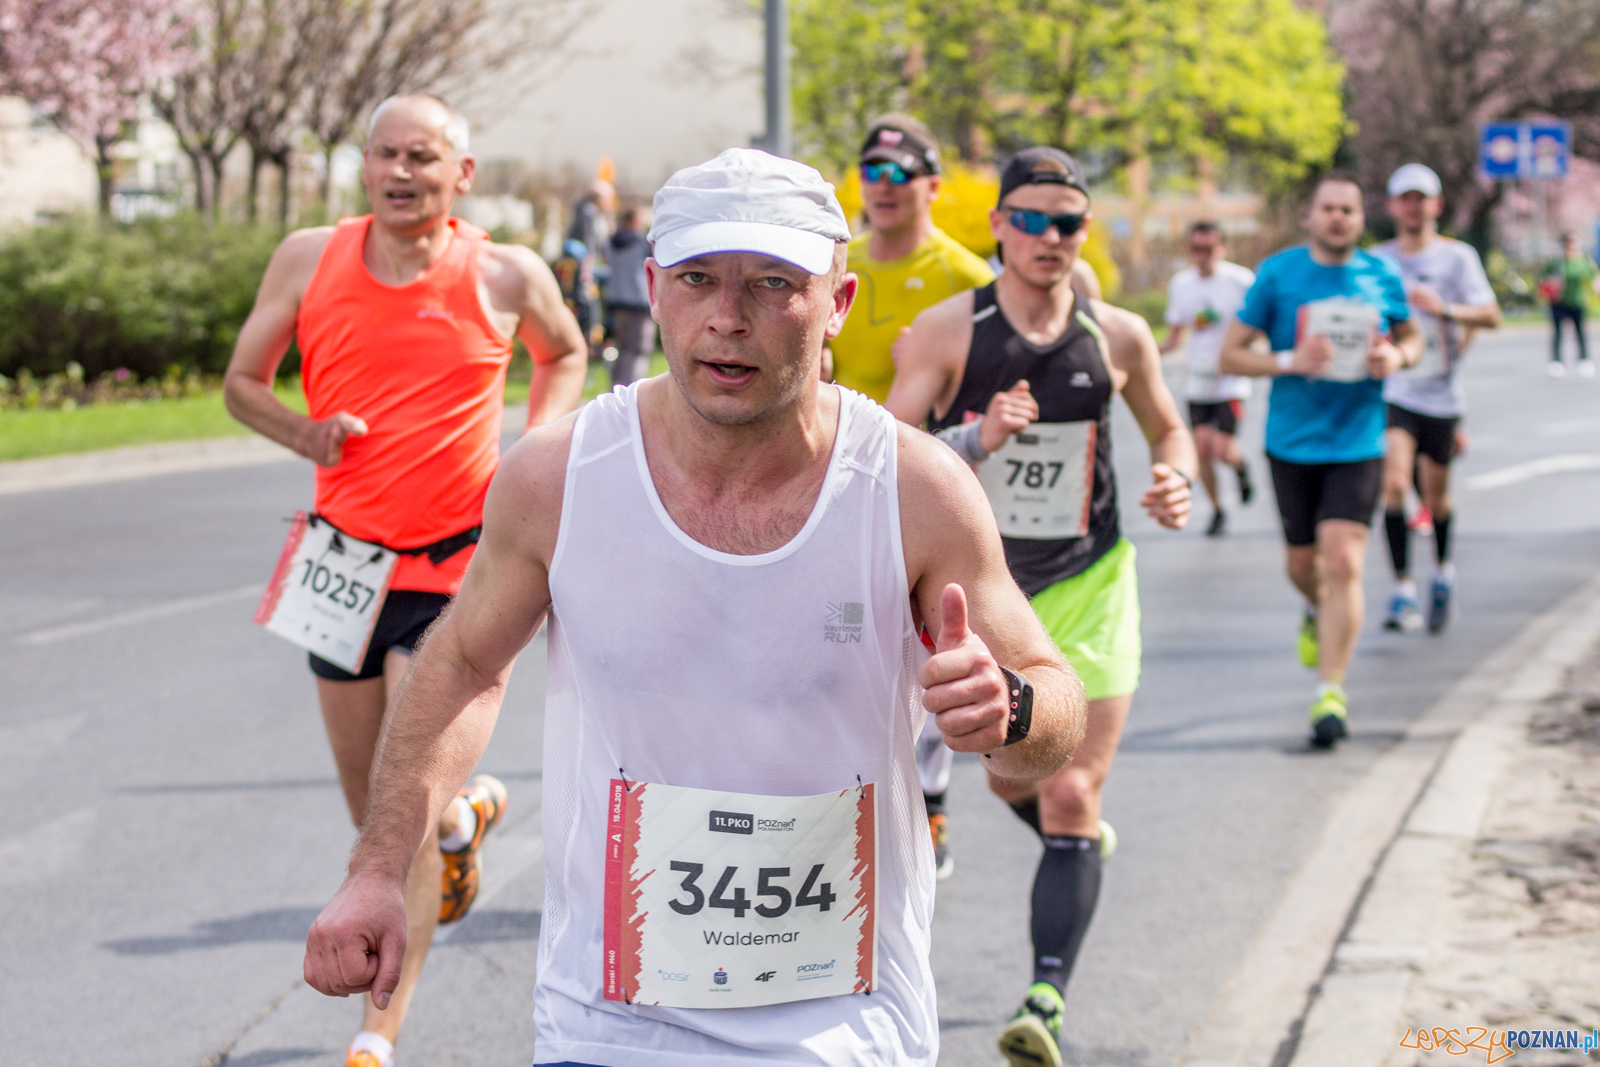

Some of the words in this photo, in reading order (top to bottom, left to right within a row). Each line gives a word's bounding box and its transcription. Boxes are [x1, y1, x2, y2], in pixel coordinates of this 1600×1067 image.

[1006, 459, 1064, 489] 787
[301, 558, 376, 614] 10257
[824, 632, 861, 643] RUN
[613, 785, 622, 822] 15.04.2018
[611, 834, 621, 842] A
[668, 860, 836, 918] 3454
[703, 930, 800, 946] Waldemar
[608, 950, 616, 964] M40
[755, 971, 777, 982] 4F
